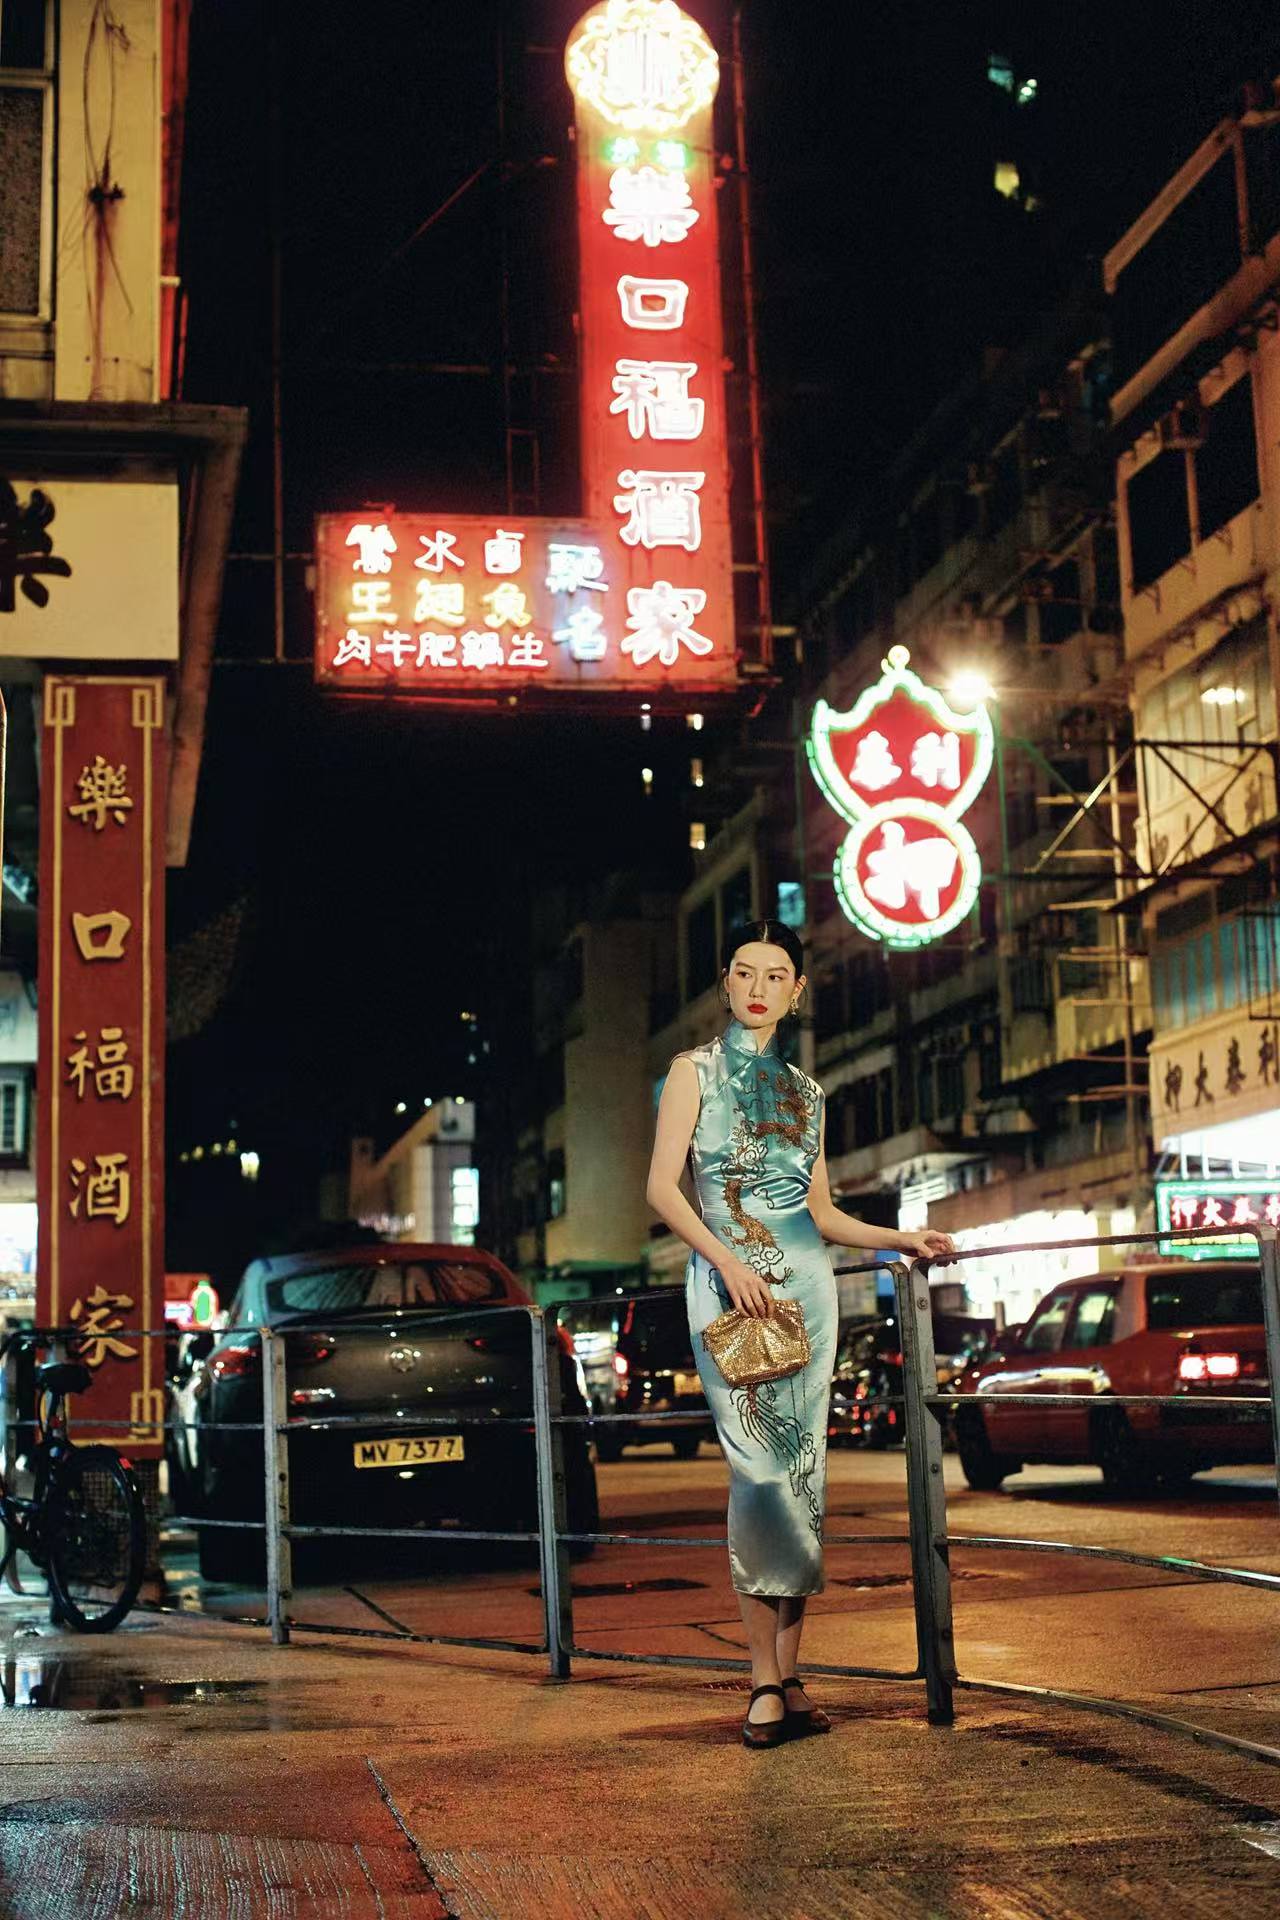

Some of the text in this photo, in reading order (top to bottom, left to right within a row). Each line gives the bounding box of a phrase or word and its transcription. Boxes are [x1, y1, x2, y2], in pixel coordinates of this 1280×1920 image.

[69, 756, 138, 1366] 樂口福酒家
[361, 1443, 389, 1462] MV
